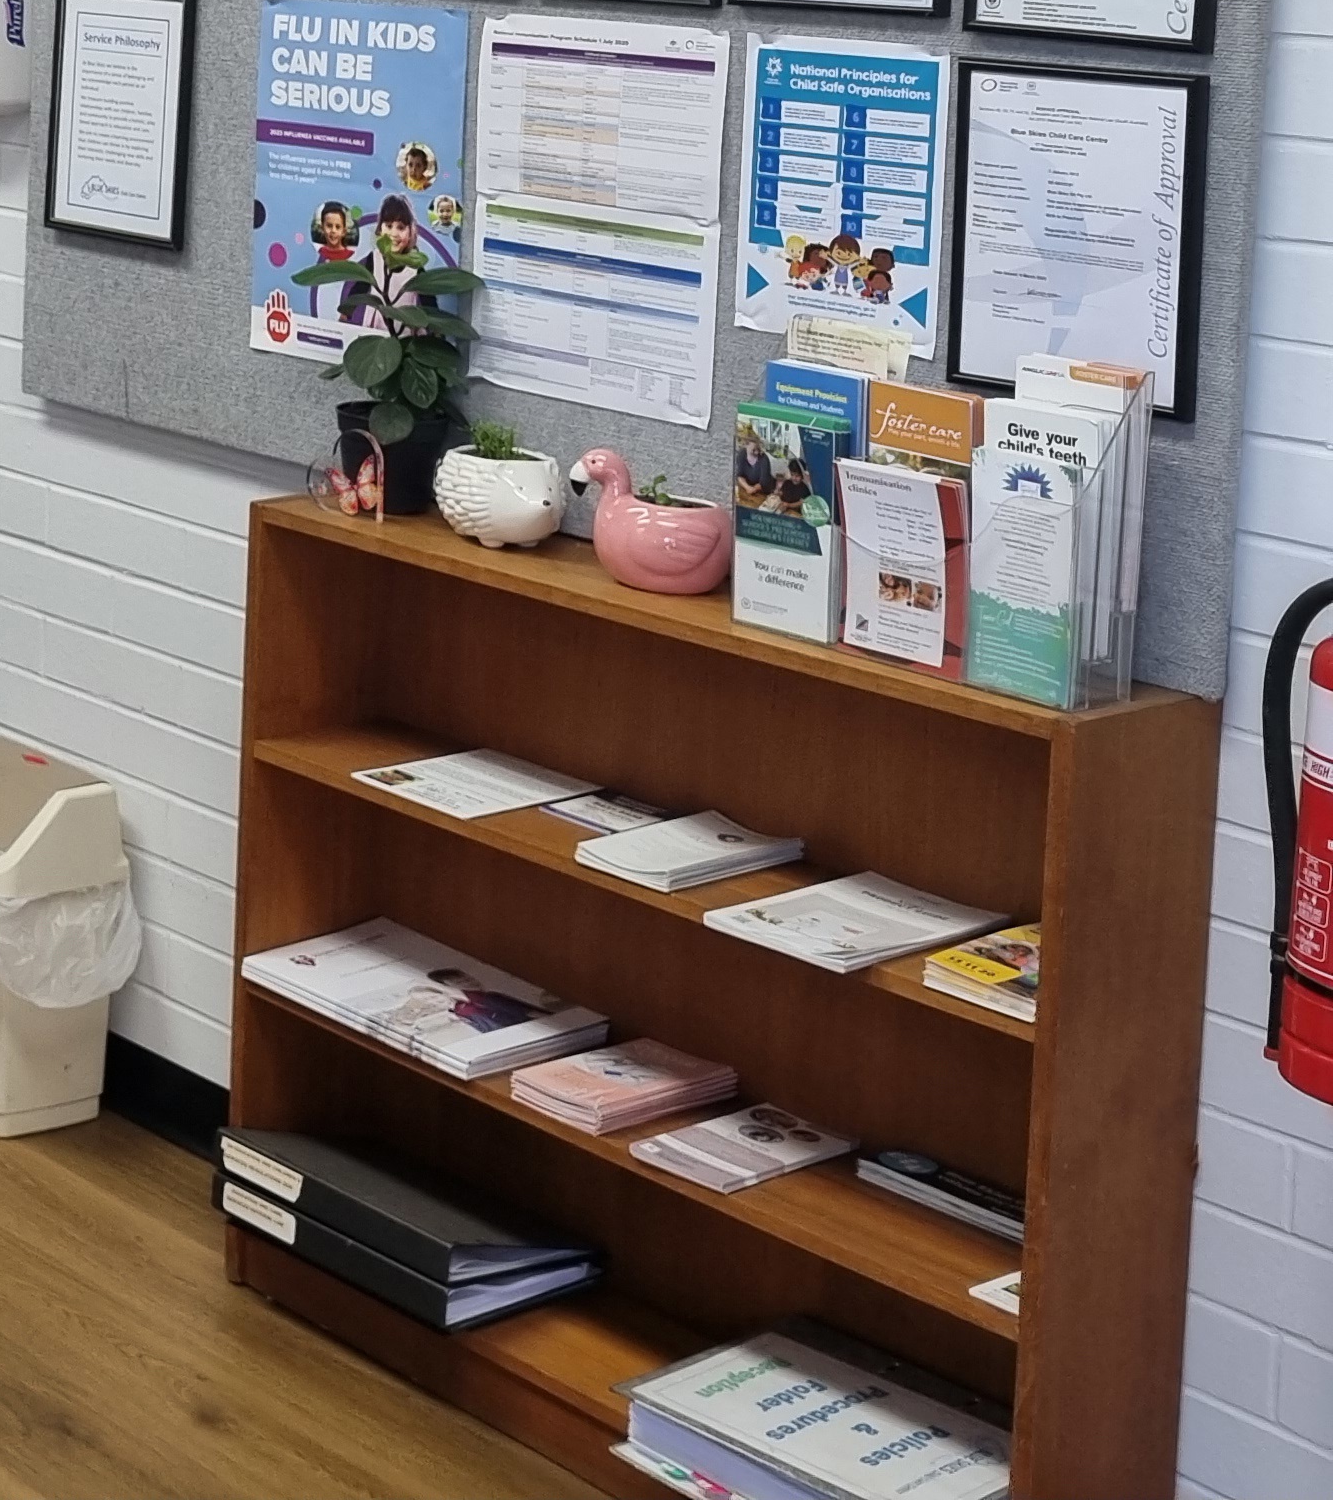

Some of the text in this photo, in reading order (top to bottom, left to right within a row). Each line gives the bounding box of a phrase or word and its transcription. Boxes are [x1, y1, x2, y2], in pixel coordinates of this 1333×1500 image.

[84, 32, 161, 51] Service Philosophy
[273, 14, 436, 52] FLU IN KIDS
[271, 47, 373, 81] CAN BE
[790, 64, 919, 85] National Principles for
[270, 80, 391, 116] SERIOUS
[790, 78, 931, 101] Child Safe Organisations
[1148, 105, 1181, 359] Certificate of Approval
[270, 319, 288, 334] FLU
[870, 403, 962, 440] foster care
[1008, 422, 1078, 447] Give your
[998, 439, 1086, 466] child's teeth
[845, 471, 912, 492] Immunisation
[847, 485, 878, 497] clinics
[754, 560, 808, 580] You can make
[765, 574, 804, 592] difference
[695, 1358, 793, 1398] Reception
[755, 1379, 828, 1413] Folder
[766, 1385, 890, 1441] Procedures
[851, 1422, 880, 1436] &
[859, 1425, 951, 1466] Policies
